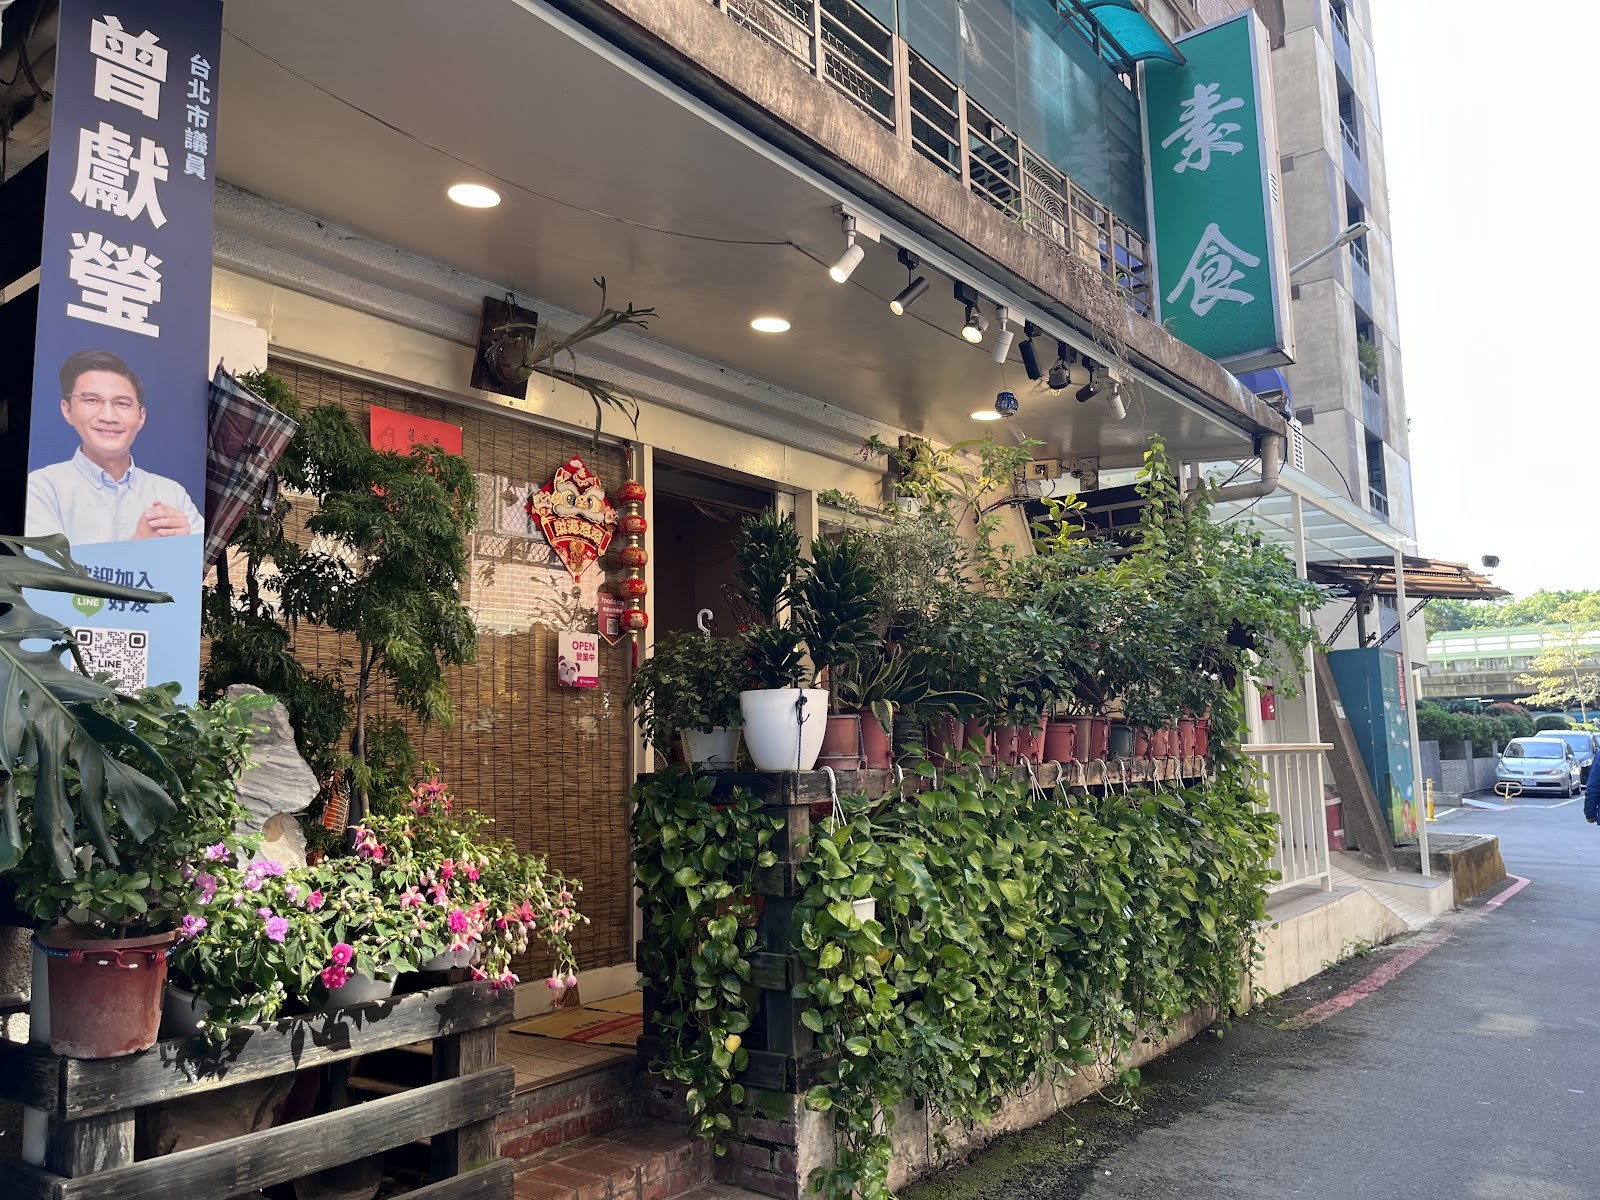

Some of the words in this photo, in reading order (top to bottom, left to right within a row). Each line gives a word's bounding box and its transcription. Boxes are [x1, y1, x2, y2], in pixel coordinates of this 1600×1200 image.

[184, 53, 211, 180] 台北市議員
[67, 15, 168, 338] 曾獻瑩
[1161, 82, 1260, 317] 素食
[81, 565, 154, 589] 迎加入
[77, 598, 99, 607] LINE
[572, 641, 595, 651] OPEN
[98, 660, 121, 669] LINE
